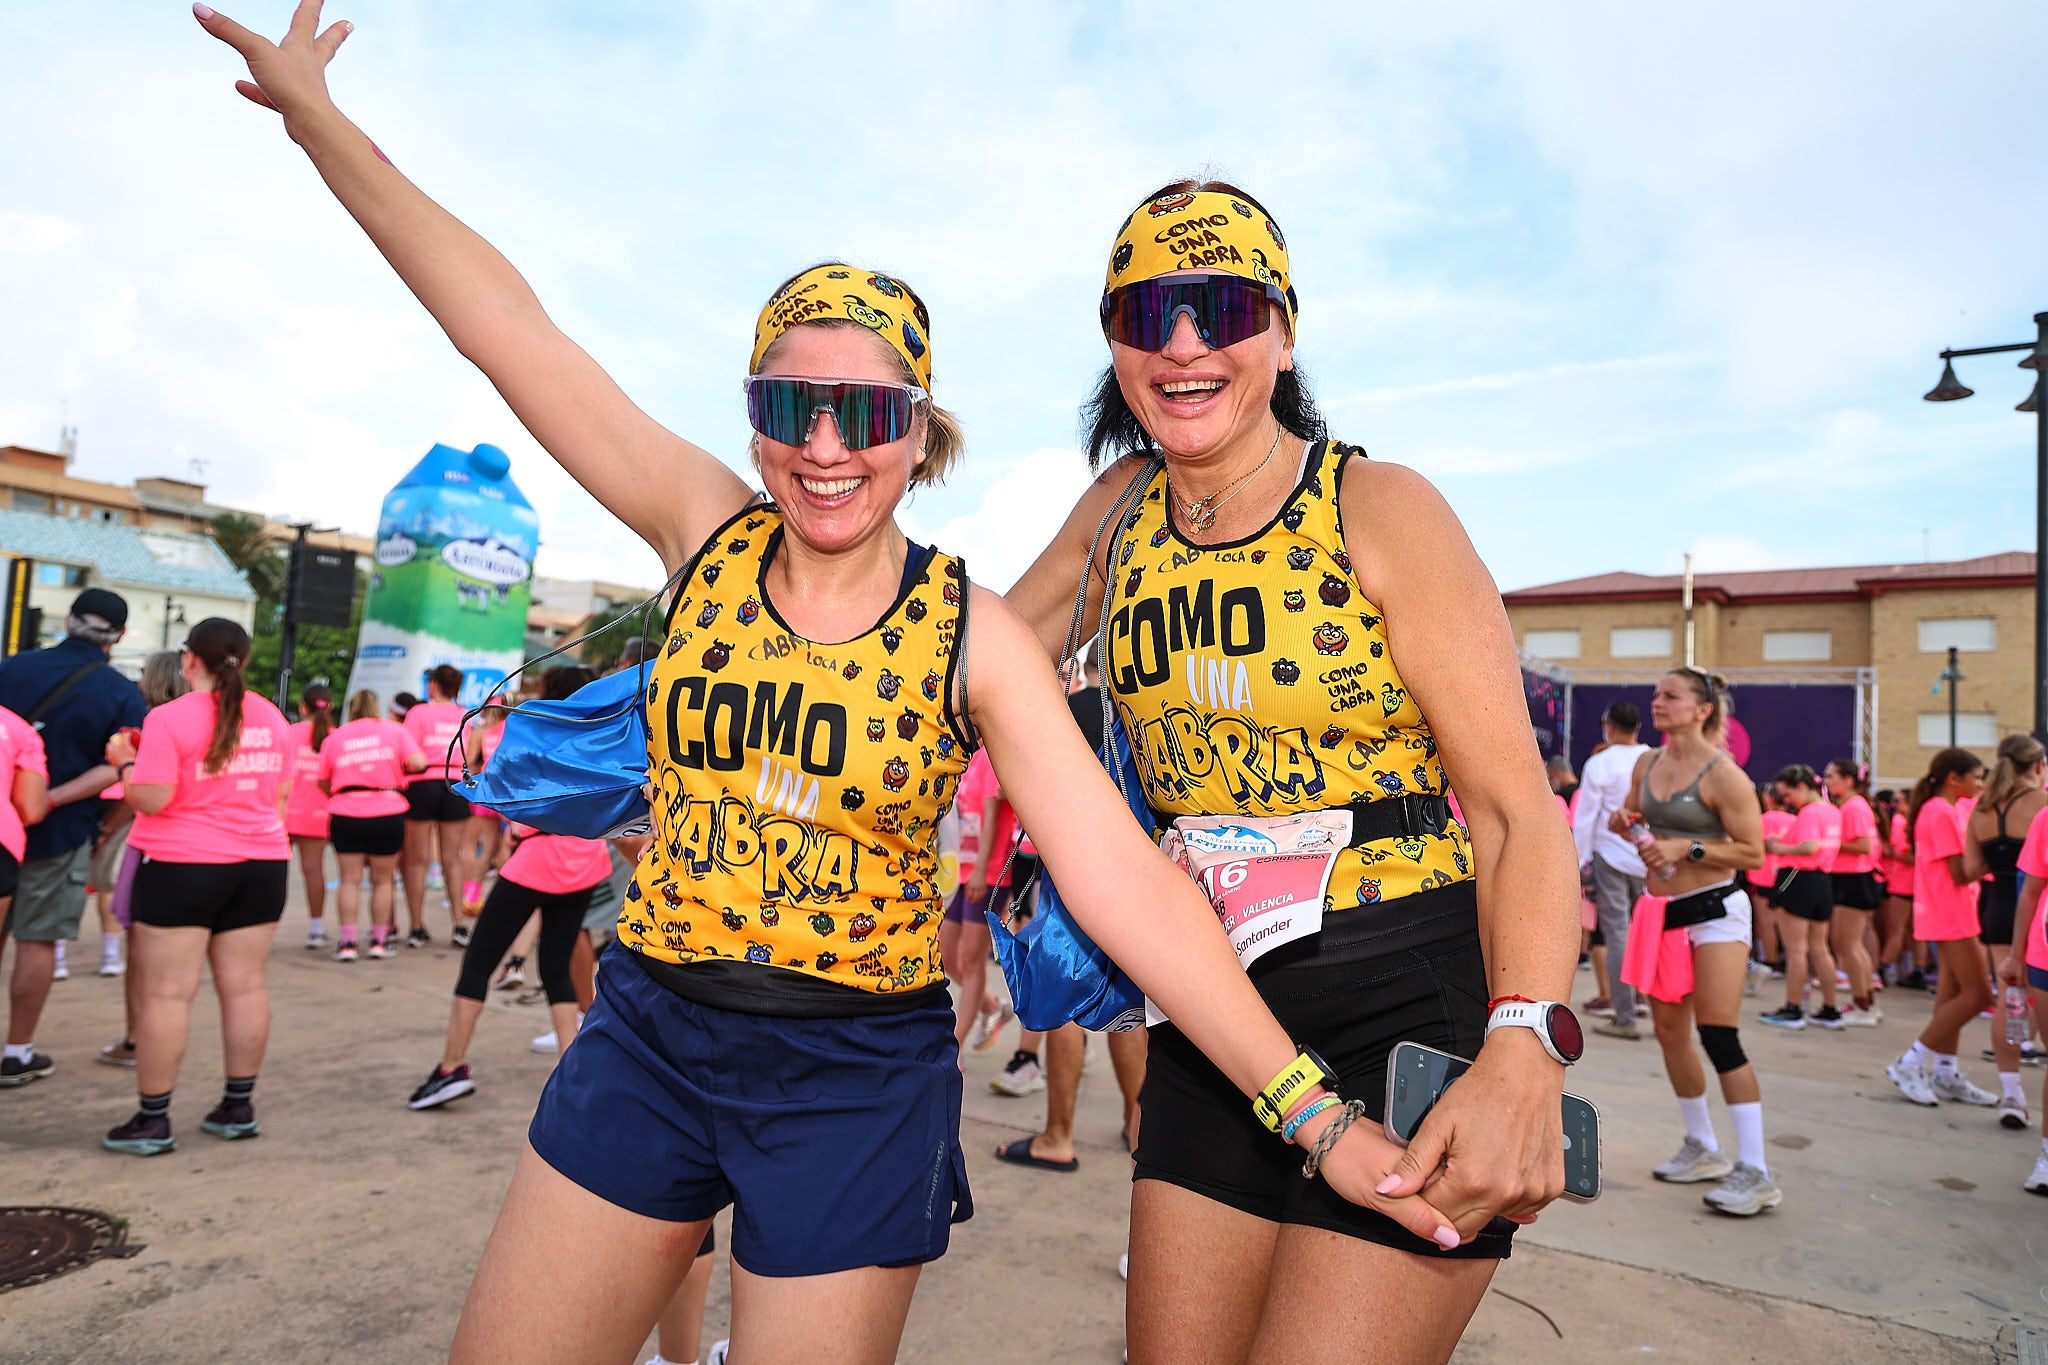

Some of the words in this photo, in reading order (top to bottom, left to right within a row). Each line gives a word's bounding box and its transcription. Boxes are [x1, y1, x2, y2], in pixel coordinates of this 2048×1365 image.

[1154, 214, 1229, 243] COMO
[1169, 230, 1221, 255] UNA
[1177, 245, 1244, 270] CABRA
[767, 283, 818, 325] COMO
[772, 298, 808, 328] UNA
[1215, 551, 1245, 563] LOCA
[1109, 579, 1266, 695] COMO
[807, 651, 837, 672] LOCA
[1318, 662, 1368, 684] COMO
[1186, 654, 1254, 712] UNA
[1328, 679, 1361, 697] UNA
[1330, 689, 1375, 712] CABRA
[666, 676, 847, 777] COMO
[755, 756, 820, 823] UNA
[875, 800, 911, 815] COMO
[1256, 853, 1326, 864] CORREDORA
[1242, 892, 1294, 918] VALENCIA
[661, 921, 692, 934] COMO
[1236, 918, 1293, 957] Santander
[664, 935, 686, 947] UNA
[854, 960, 881, 975] UNA
